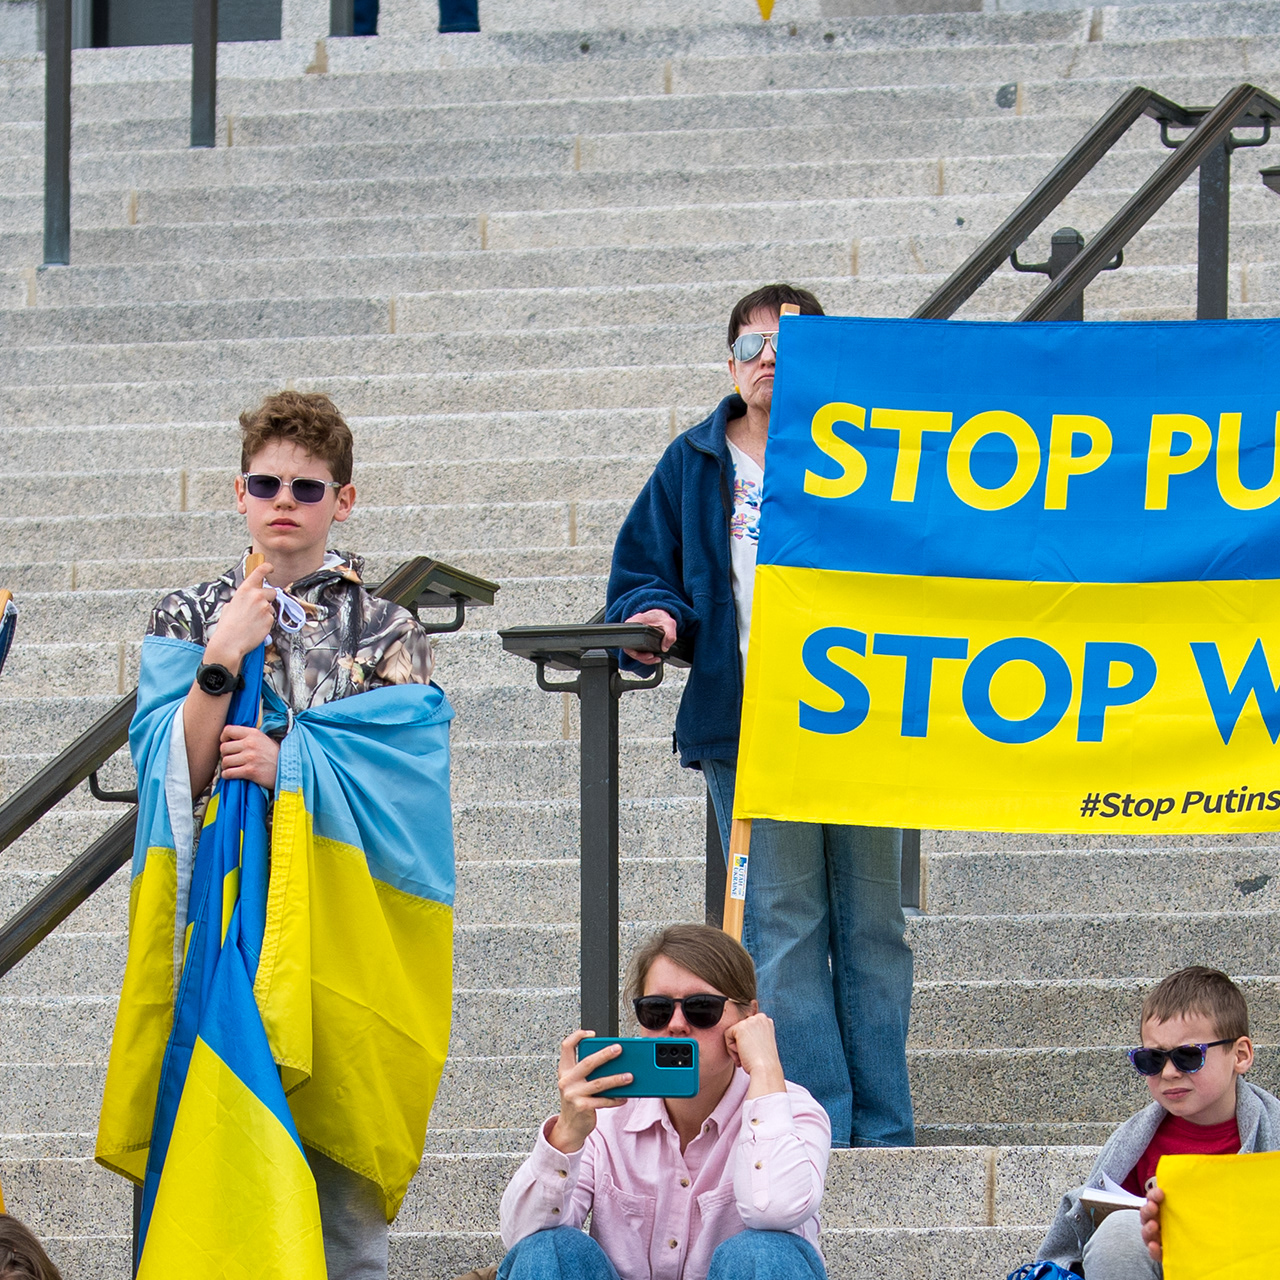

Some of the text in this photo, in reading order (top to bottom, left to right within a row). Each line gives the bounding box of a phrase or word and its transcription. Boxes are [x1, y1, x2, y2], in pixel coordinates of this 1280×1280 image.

[803, 401, 1113, 512] STOP
[798, 626, 1158, 745] STOP
[1079, 790, 1176, 822] #Stop
